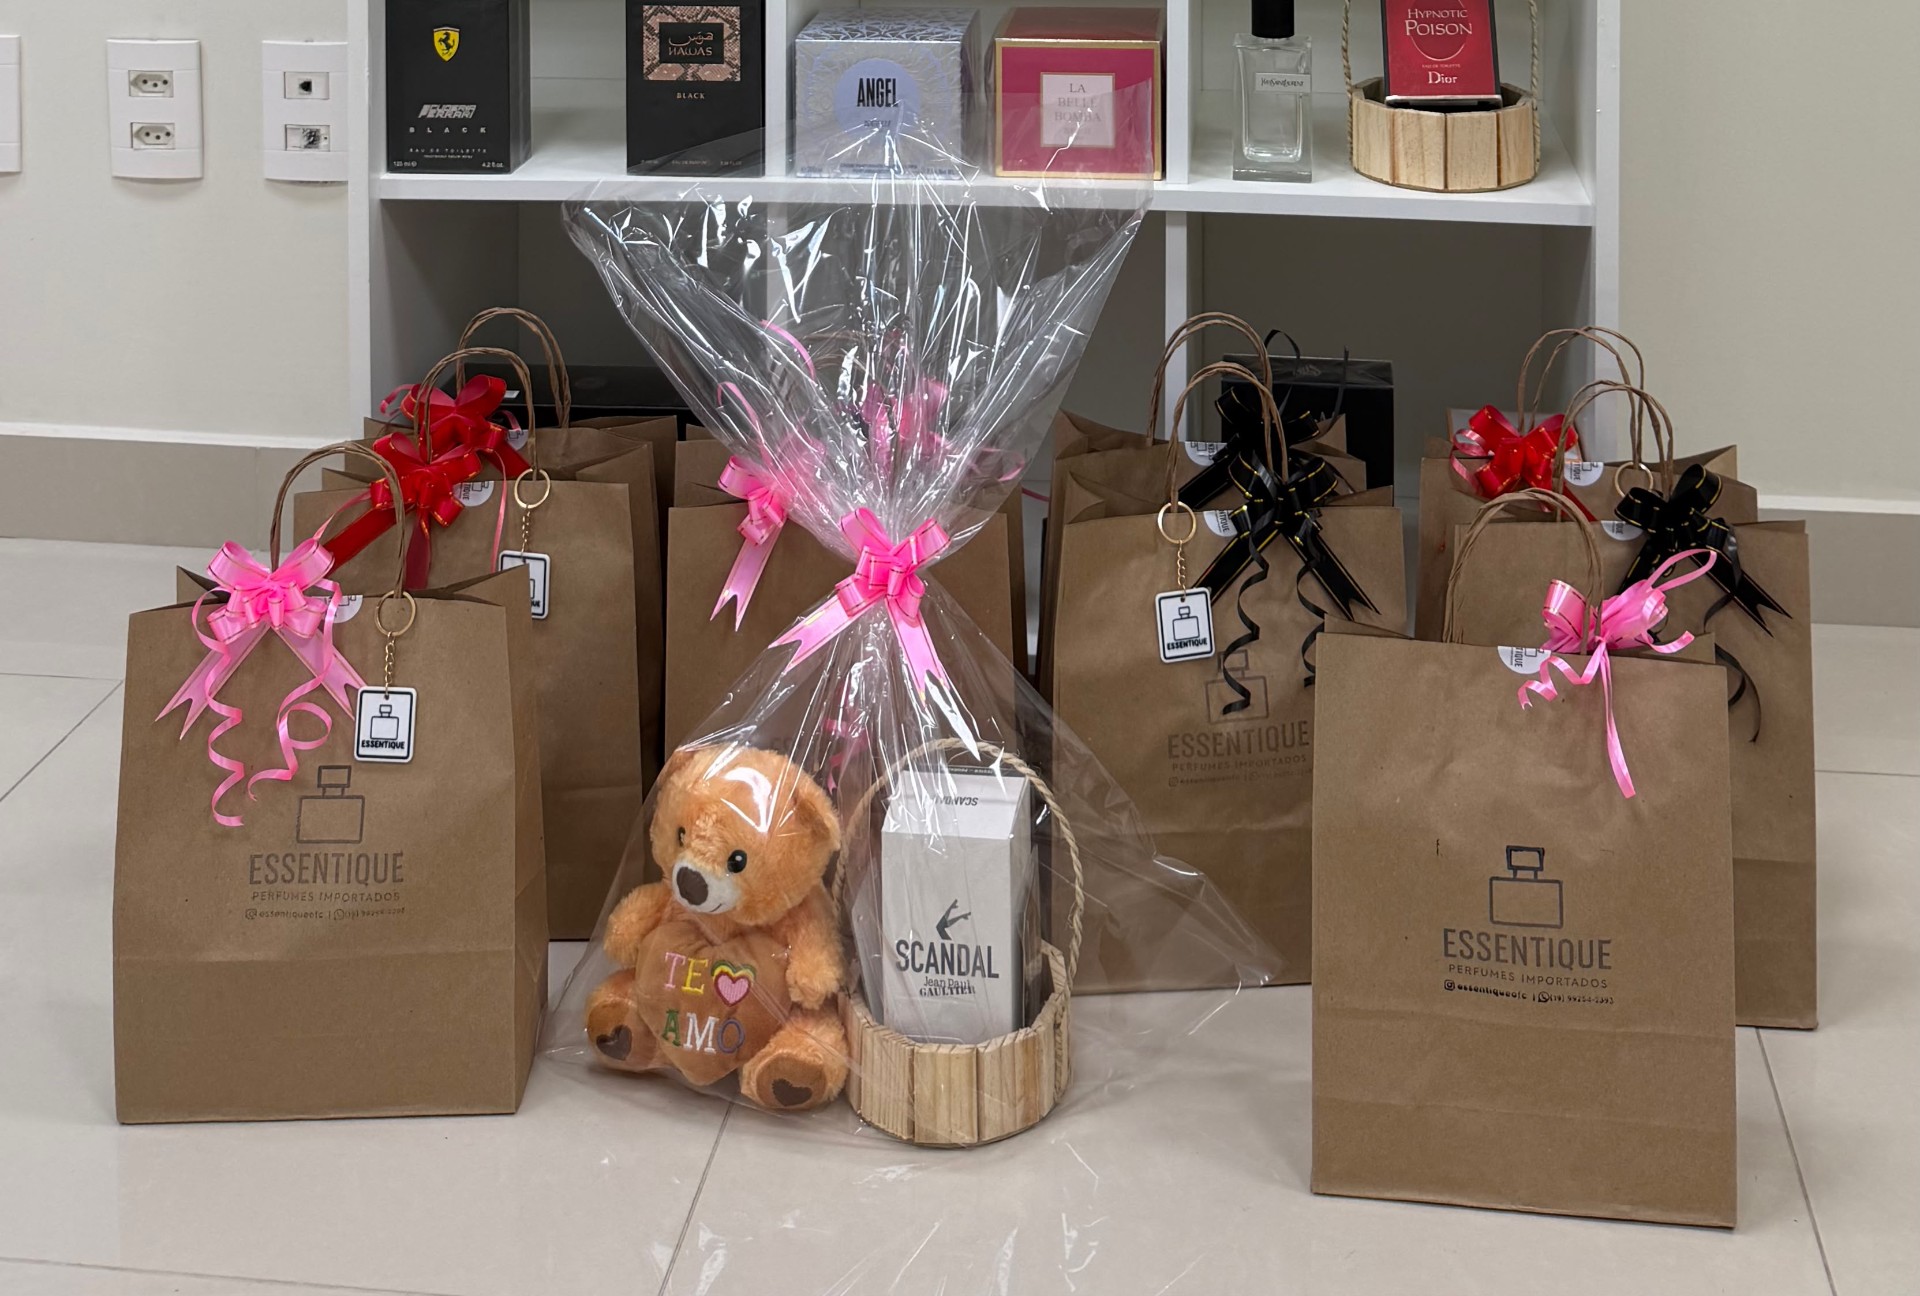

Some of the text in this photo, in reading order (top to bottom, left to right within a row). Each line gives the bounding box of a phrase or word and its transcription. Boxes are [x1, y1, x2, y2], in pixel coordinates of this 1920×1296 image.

[1407, 8, 1468, 19] HYPNOTIC
[1405, 19, 1473, 36] POISON
[1428, 70, 1458, 84] Dior
[856, 77, 899, 108] ANGEL
[1069, 83, 1086, 93] LA
[1167, 637, 1208, 651] ESSENTIQUE
[361, 739, 405, 750] ESSENTIQUE
[1167, 720, 1310, 760] ESSENTIQUE
[1172, 754, 1307, 772] PERFUMES IMPORTADOS
[249, 851, 404, 887] ESSENTIQUE
[252, 890, 401, 903] PERFUMES IMPORTADOS
[1443, 928, 1612, 971] ESSENTIQUE
[895, 939, 1000, 979] SCANDAL
[664, 952, 709, 995] TE
[1449, 964, 1608, 989] PERFUMES IMPORTADOS
[919, 985, 976, 998] GAULTIER
[924, 976, 970, 990] Jean Paul
[661, 1008, 746, 1055] AMO
